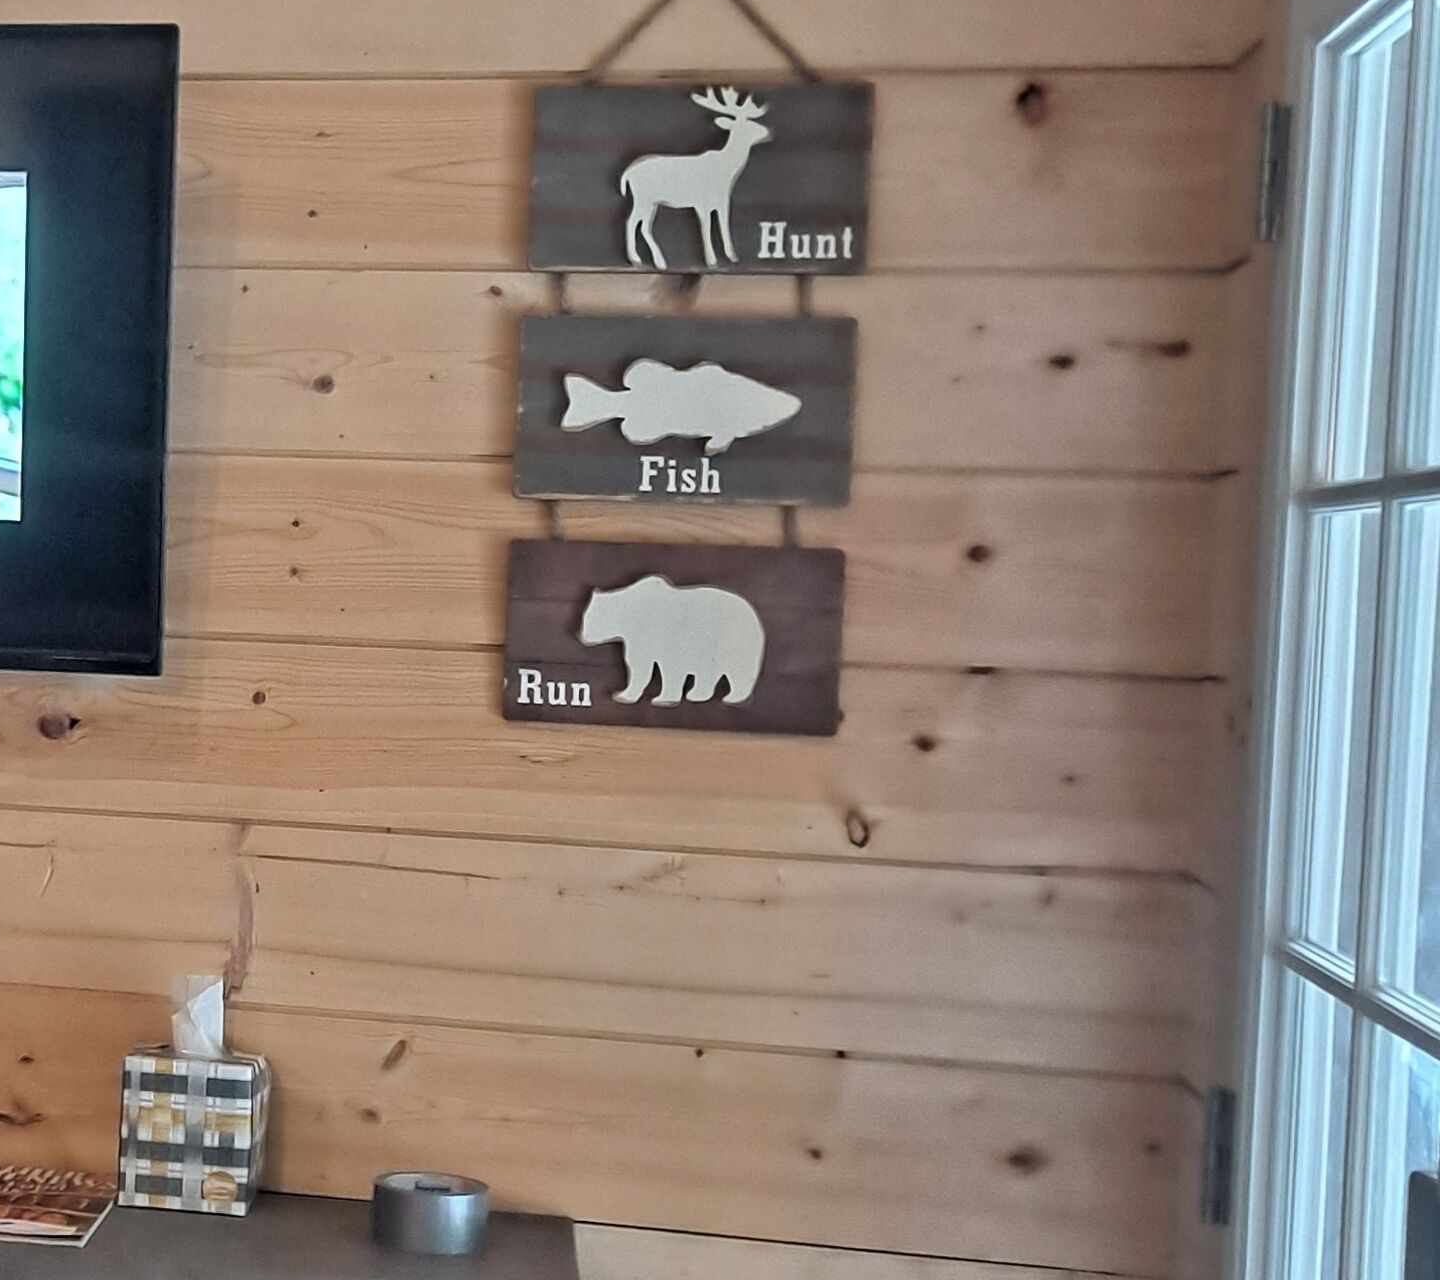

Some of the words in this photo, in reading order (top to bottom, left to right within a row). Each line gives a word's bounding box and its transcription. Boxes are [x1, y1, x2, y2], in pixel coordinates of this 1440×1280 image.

[758, 222, 852, 258] Hunt
[639, 456, 720, 493] Fish
[518, 669, 591, 706] Run
